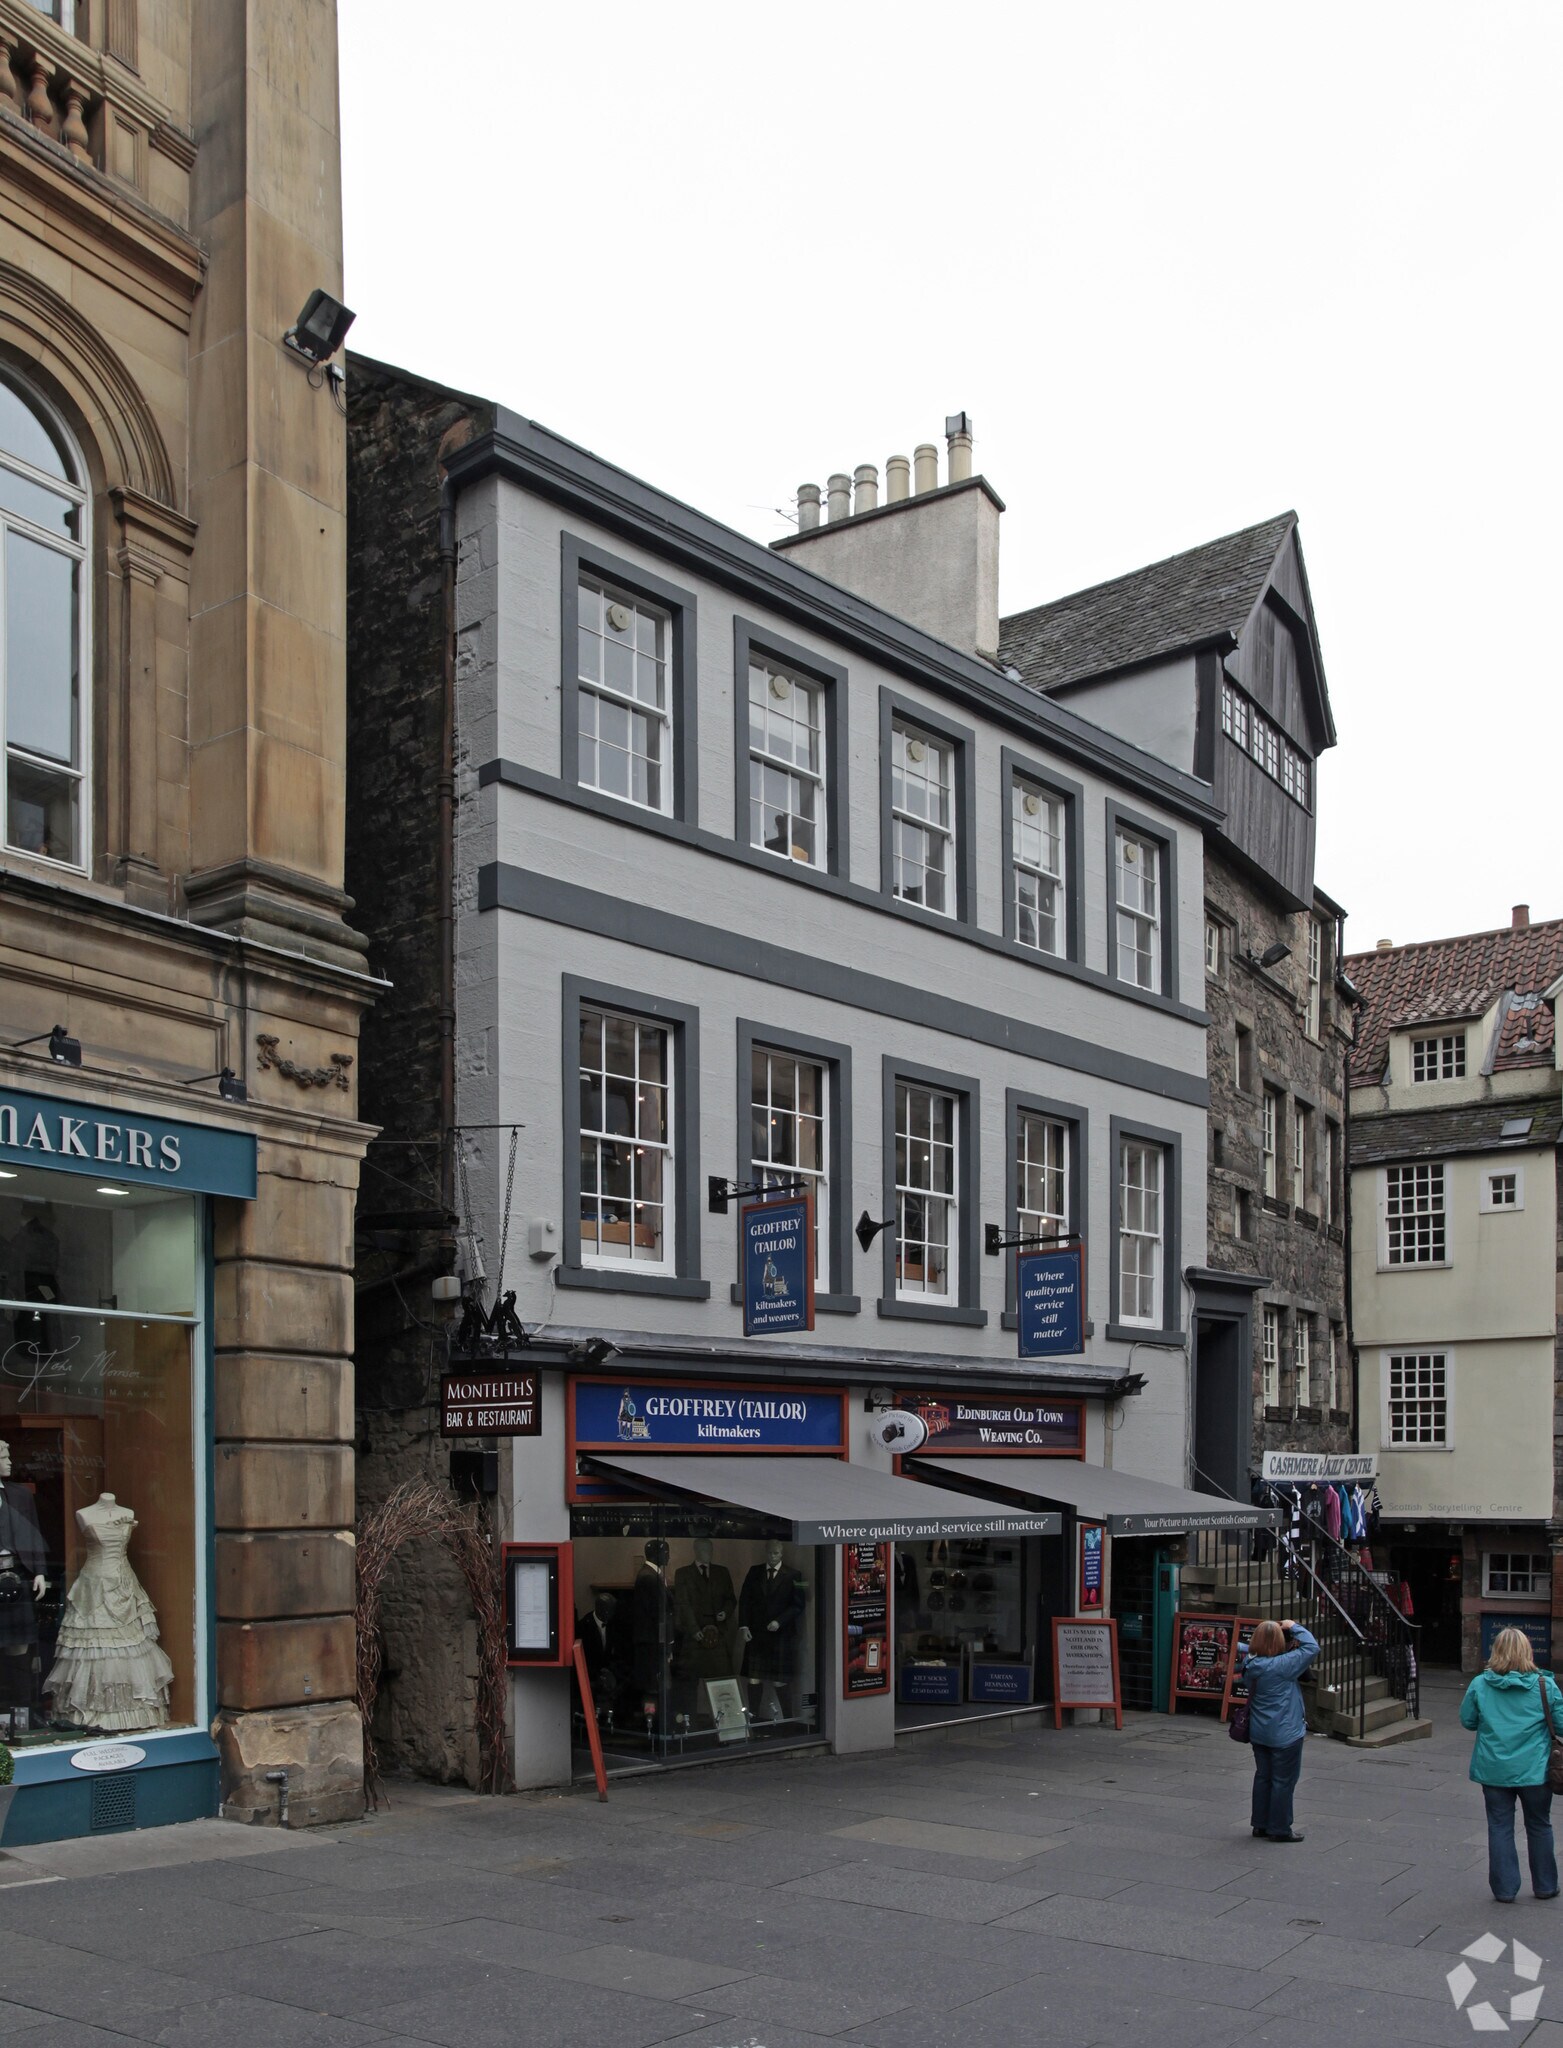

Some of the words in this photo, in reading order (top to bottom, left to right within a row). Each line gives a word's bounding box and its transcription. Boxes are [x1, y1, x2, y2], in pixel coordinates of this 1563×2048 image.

[750, 1218, 801, 1236] GEOFFREY
[754, 1236, 796, 1255] (TAILOR)
[1025, 1286, 1056, 1299] quality
[1056, 1283, 1074, 1294] and
[755, 1298, 797, 1311] kiltmakers
[1034, 1300, 1065, 1311] service
[753, 1313, 768, 1324] and
[768, 1312, 800, 1323] weavers
[1041, 1313, 1058, 1324] still
[447, 1378, 533, 1400] MONTEITHS
[645, 1396, 736, 1418] GEOFFREY
[738, 1398, 807, 1423] (TAILOR)
[446, 1412, 463, 1428] BAR
[467, 1411, 474, 1427] &
[478, 1409, 533, 1427] RESTAURANT
[697, 1423, 761, 1438] kiltmakers
[1269, 1456, 1319, 1476] CASHMERE
[1323, 1458, 1346, 1476] KILT
[1344, 1457, 1373, 1475] CENTRE
[1388, 1503, 1423, 1512] Scottish
[1428, 1503, 1482, 1514] Storytelling
[1489, 1503, 1523, 1512] Centre
[869, 1523, 914, 1538] quality
[916, 1522, 939, 1535] and
[941, 1521, 982, 1533] service
[984, 1519, 1005, 1532] still
[1143, 1518, 1159, 1528] Your
[1159, 1517, 1181, 1528] Picture
[1182, 1517, 1188, 1526] in
[1187, 1516, 1211, 1527] Ancient
[1211, 1515, 1234, 1526] Scottish
[1234, 1515, 1259, 1525] Costume
[1524, 1623, 1546, 1631] House
[99, 1746, 128, 1756] WEDDING
